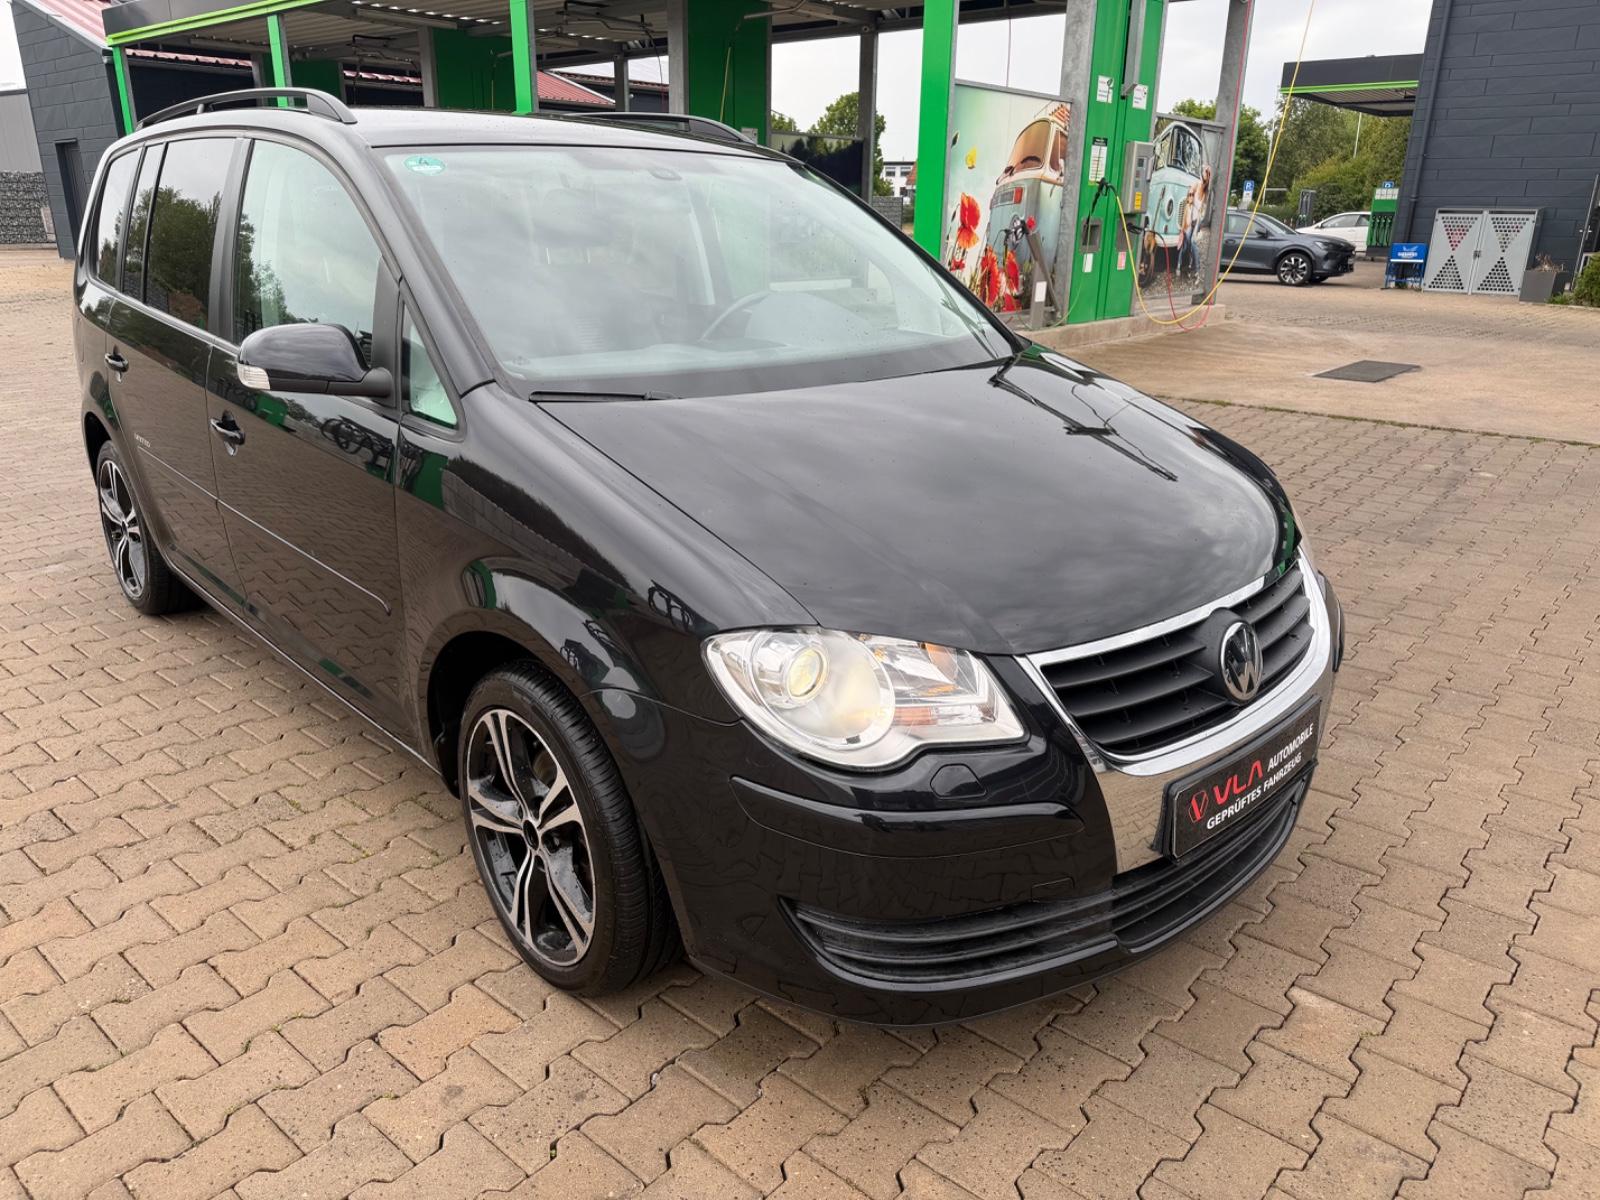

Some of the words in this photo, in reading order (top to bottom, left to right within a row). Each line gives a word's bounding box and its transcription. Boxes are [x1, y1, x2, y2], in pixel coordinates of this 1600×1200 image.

[1207, 785, 1262, 829] GEPRÜFTES
[1263, 752, 1302, 791] FAHRZEUG
[1213, 760, 1263, 805] VLA
[1267, 723, 1314, 772] AUTOMOBILE
